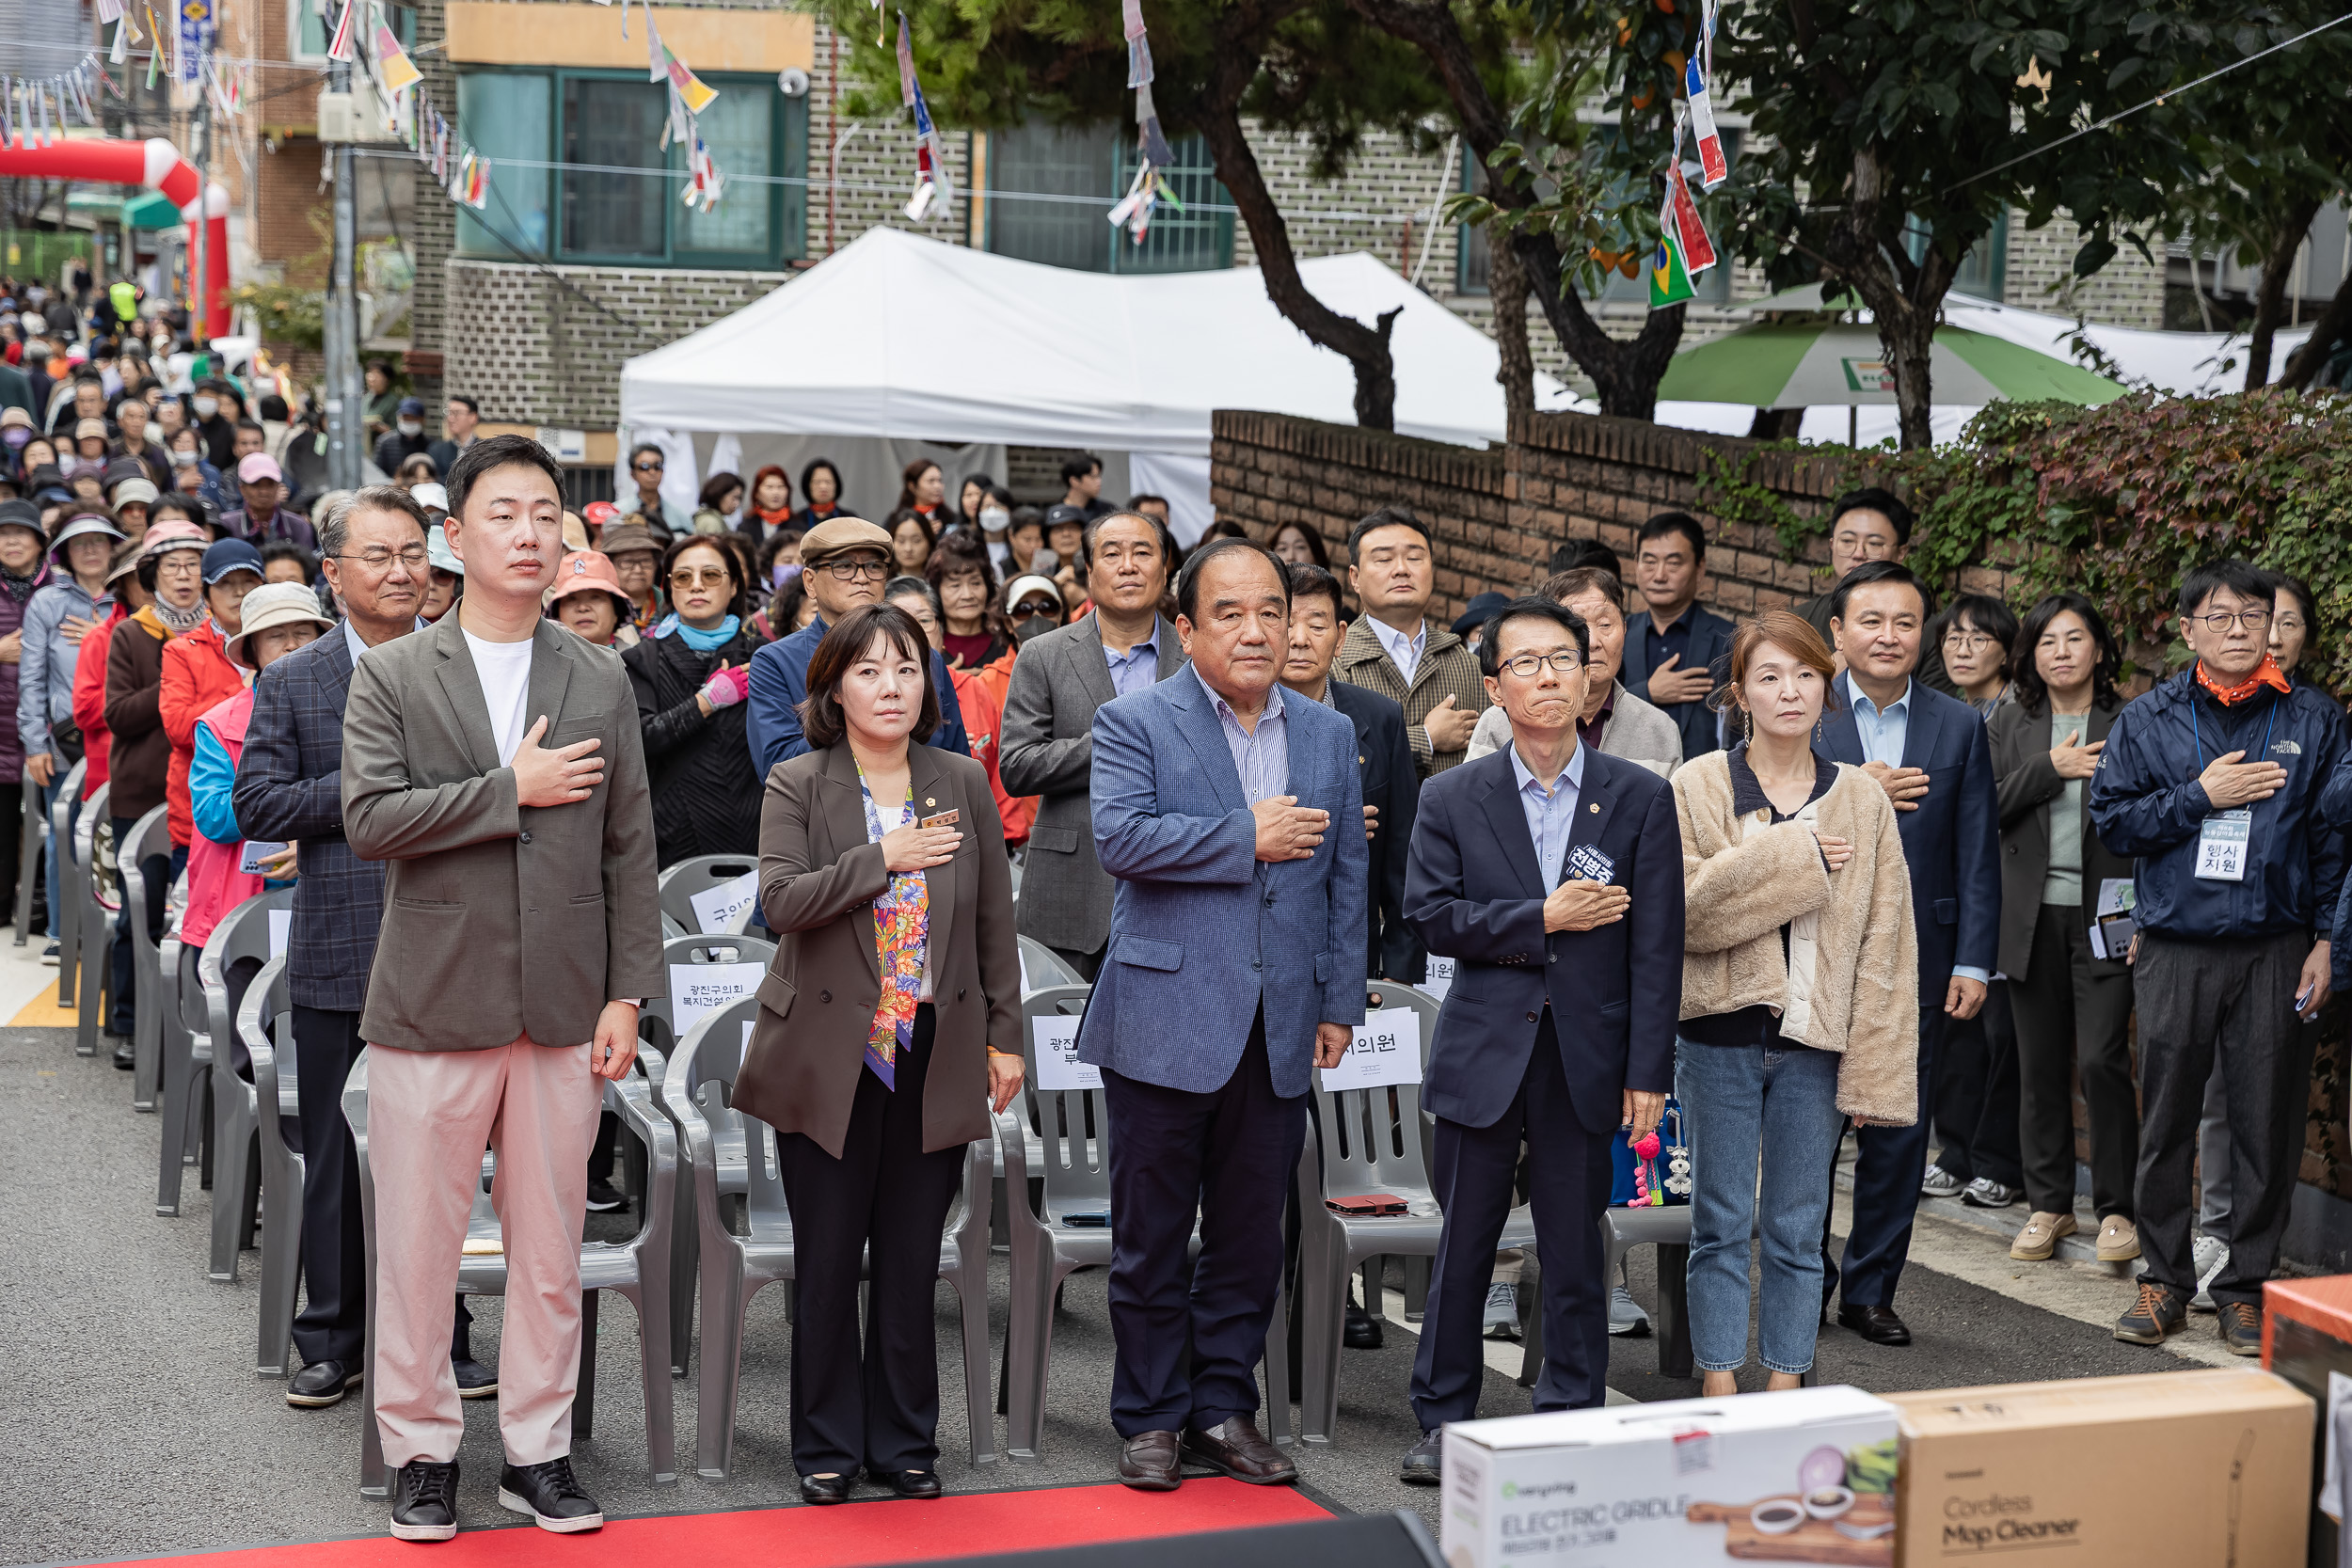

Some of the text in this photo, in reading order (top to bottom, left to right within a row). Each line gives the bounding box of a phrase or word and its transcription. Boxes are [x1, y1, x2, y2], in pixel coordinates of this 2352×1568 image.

[2207, 845, 2239, 858] 행사
[1570, 847, 1613, 883] 전병주
[2205, 859, 2236, 873] 지원
[690, 984, 743, 996] 광진구의회
[1049, 1038, 1076, 1052] 광진
[1943, 1494, 2033, 1521] Cordless
[1502, 1504, 1609, 1536] ELECTRIC
[1943, 1519, 2079, 1550] Mop Cleaner
